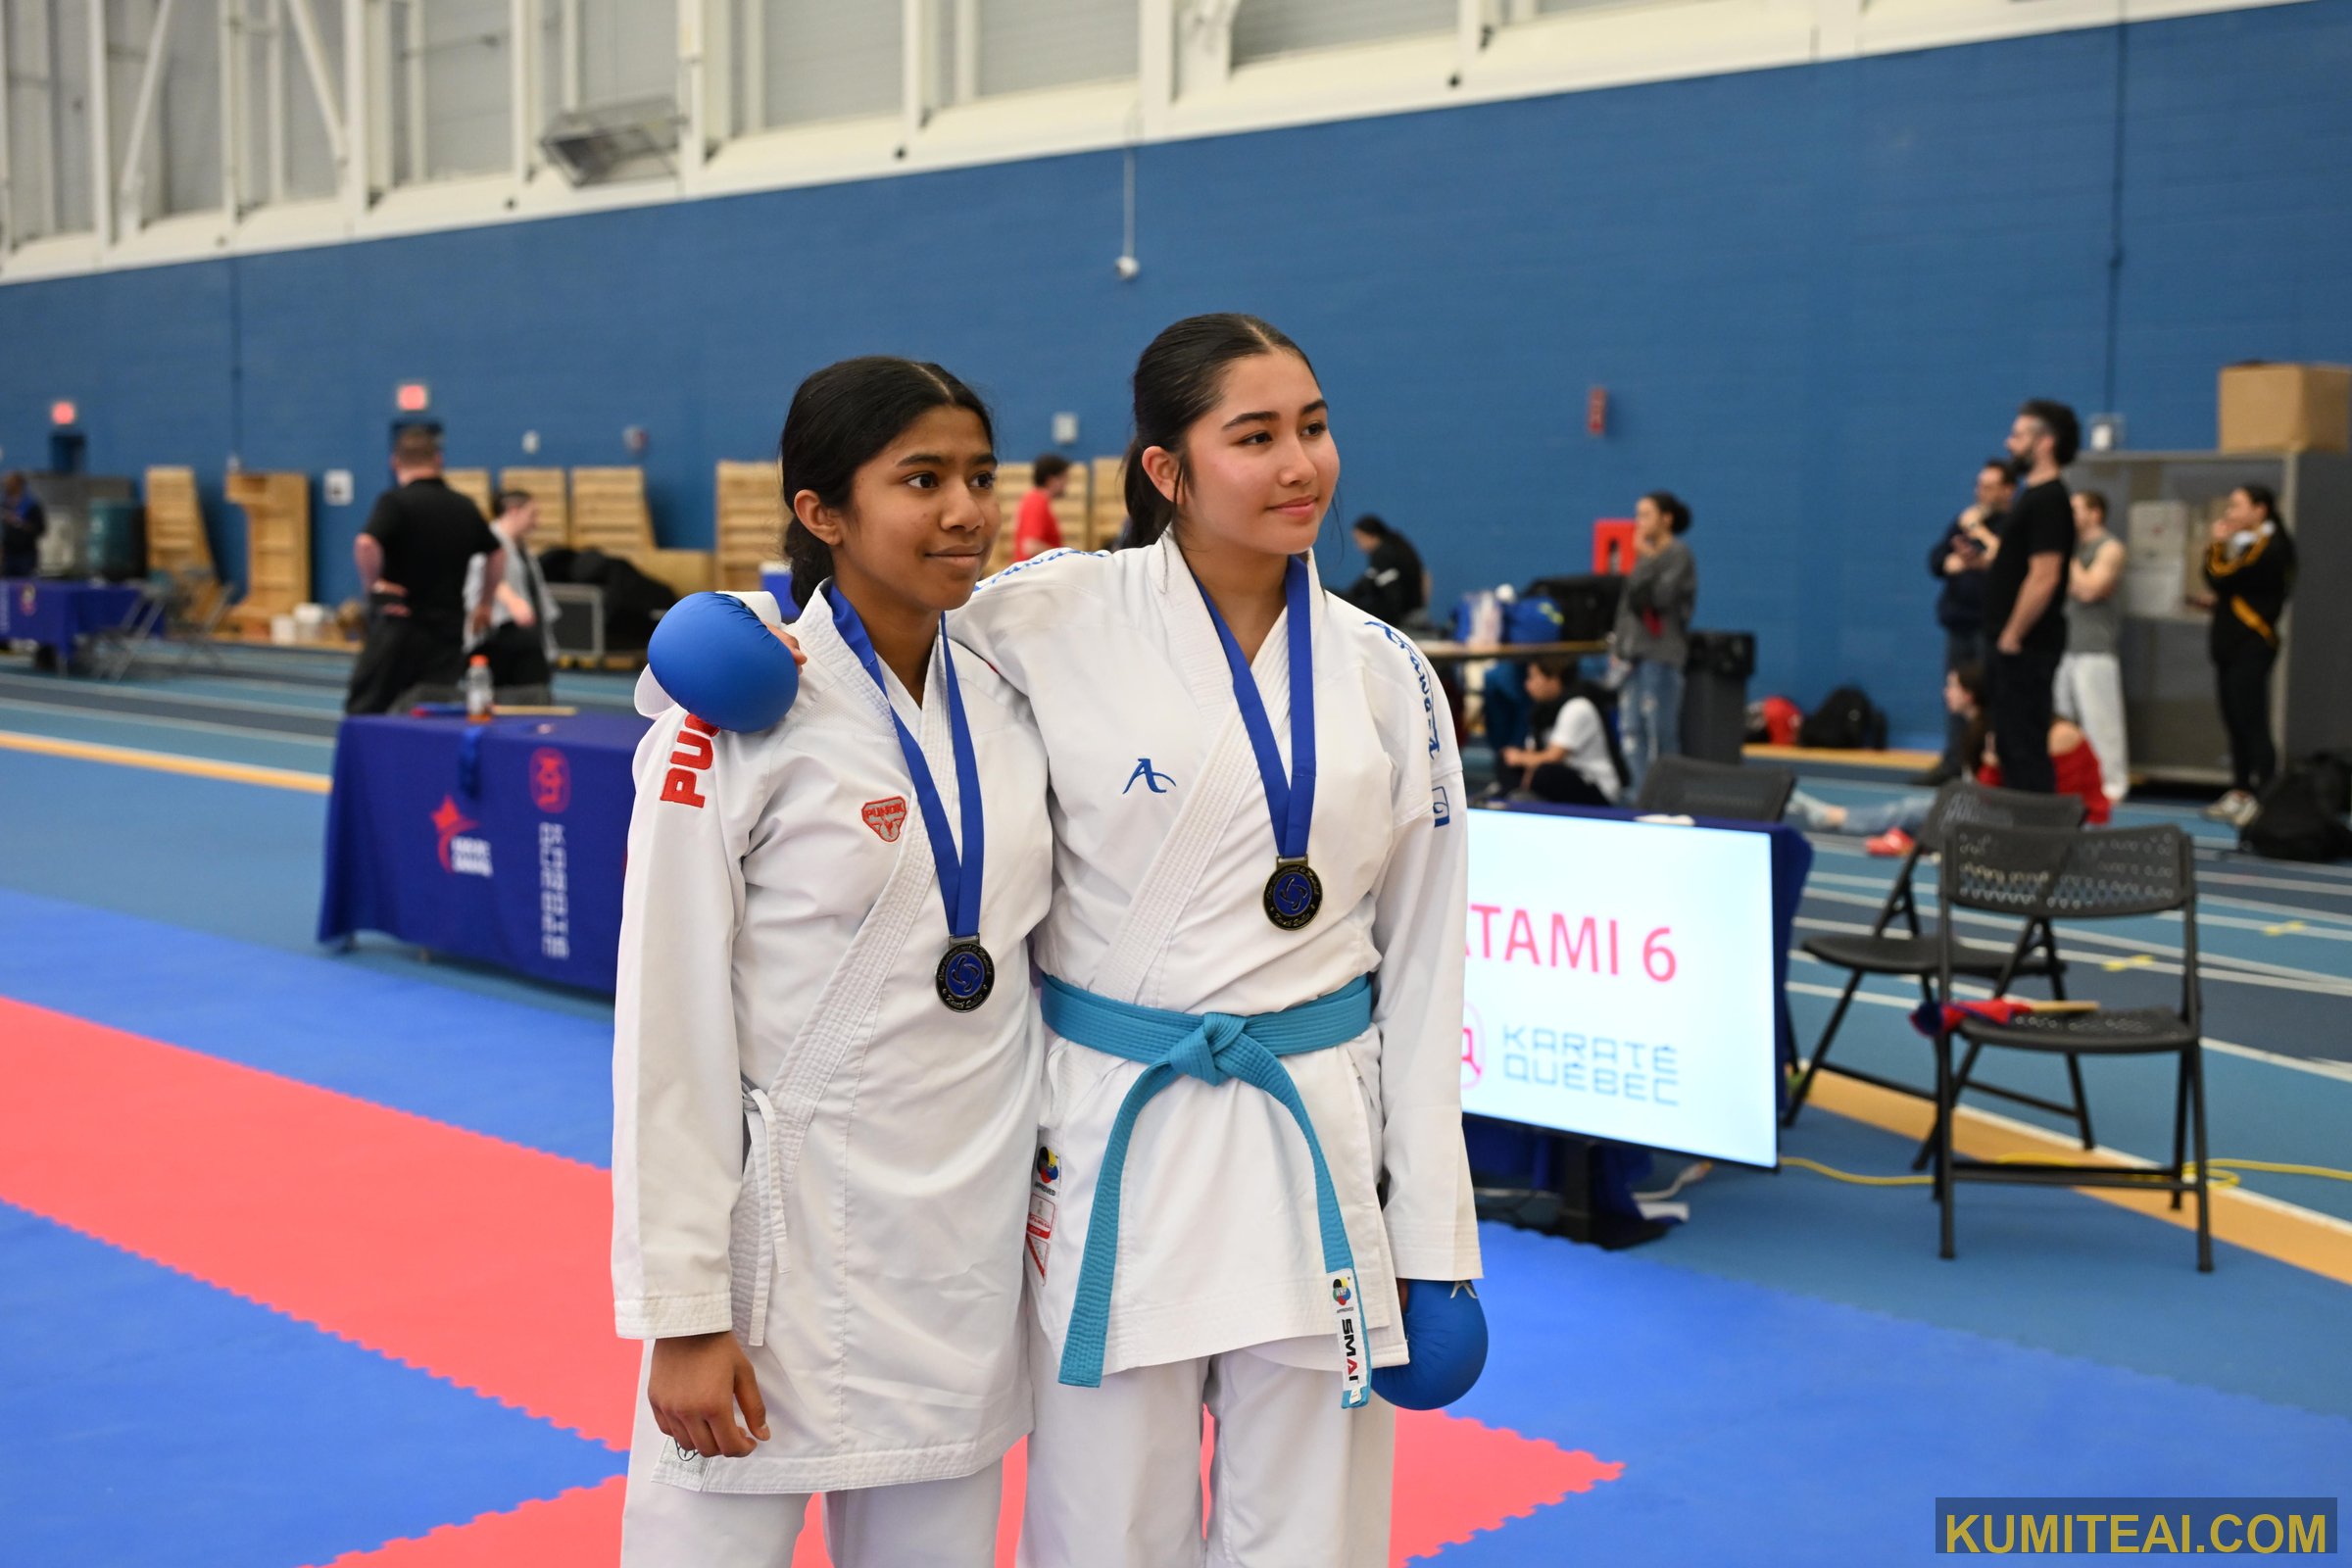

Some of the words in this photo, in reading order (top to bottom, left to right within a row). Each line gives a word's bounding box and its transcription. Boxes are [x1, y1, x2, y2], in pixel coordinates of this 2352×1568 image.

[1464, 903, 1619, 977] TAMI
[1642, 925, 1677, 984] 6
[1502, 1023, 1680, 1077] KARATÉ
[1341, 1318, 1359, 1382] SMAI
